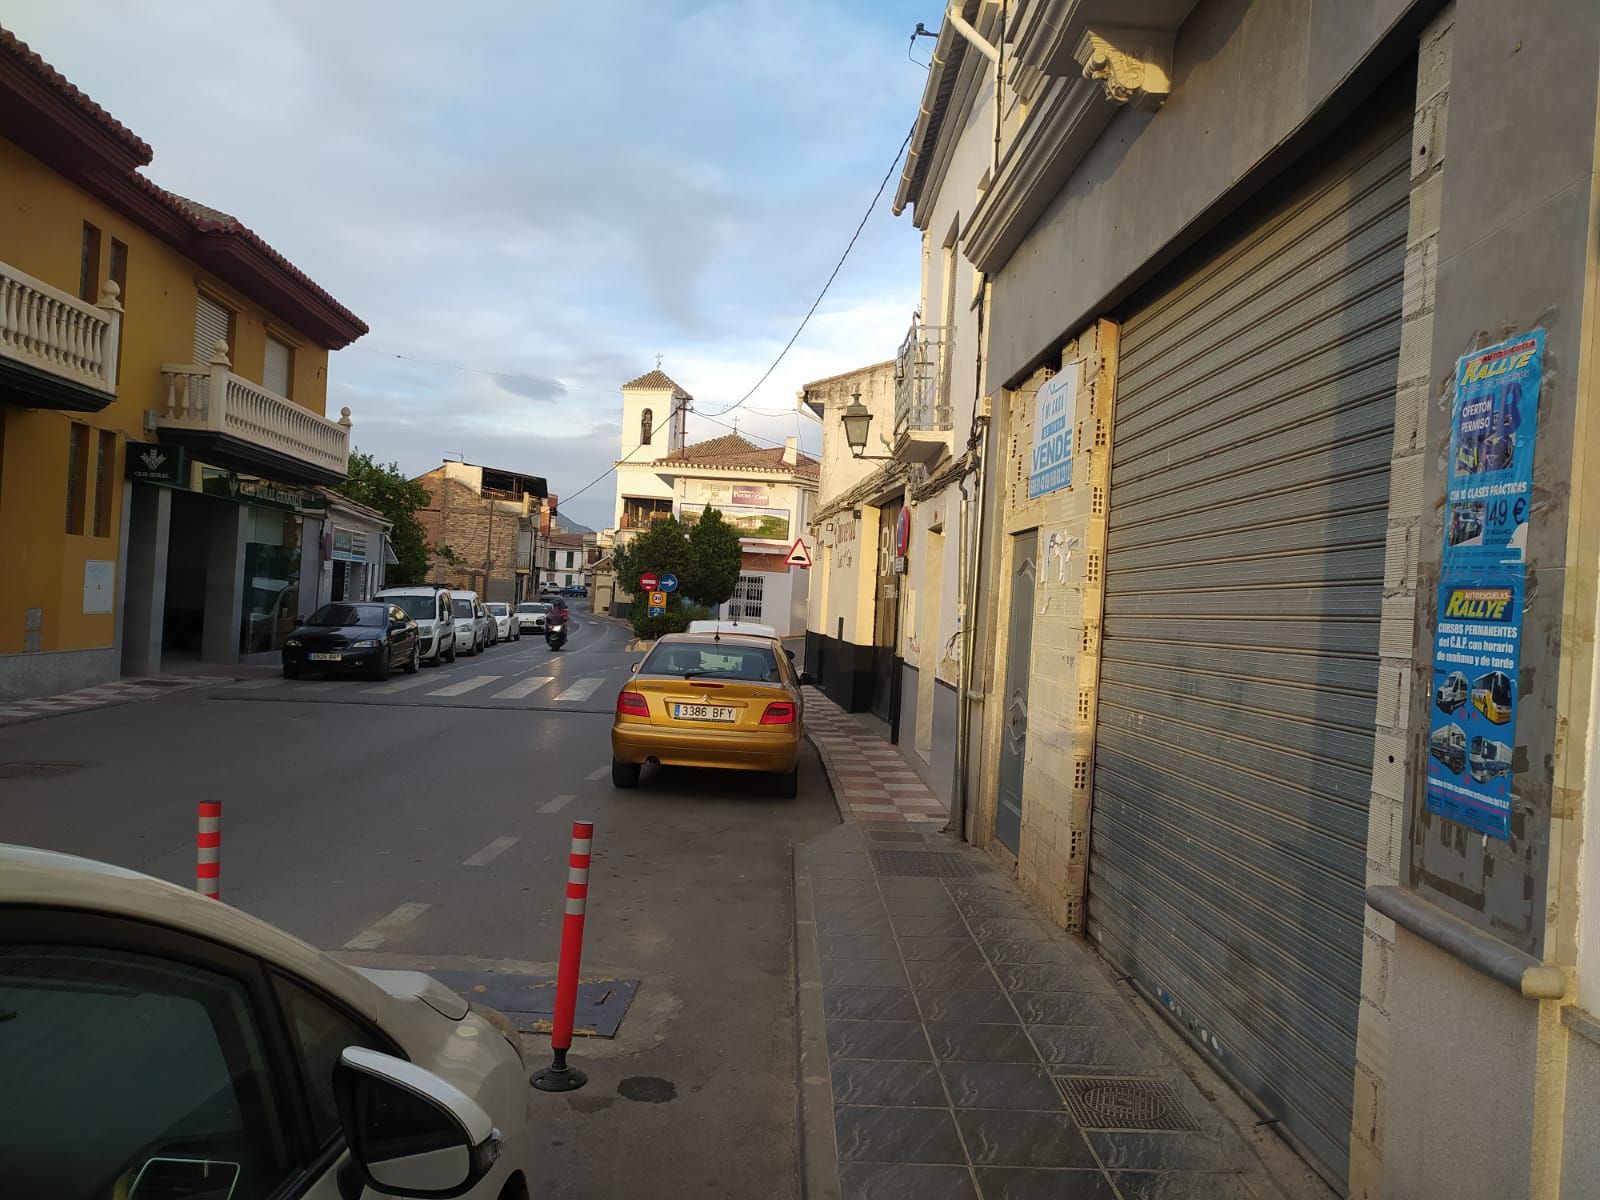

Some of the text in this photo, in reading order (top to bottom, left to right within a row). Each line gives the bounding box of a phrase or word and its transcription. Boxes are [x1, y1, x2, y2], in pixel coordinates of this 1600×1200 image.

[1460, 349, 1536, 386] RALLYE
[1461, 417, 1491, 433] PERMISO
[1033, 428, 1072, 472] VENDE
[1467, 486, 1489, 498] CLASES
[1513, 497, 1526, 525] €
[881, 523, 898, 576] BA
[1464, 591, 1509, 600] AUTOESCUELAS
[1445, 591, 1508, 619] RALLYE
[1438, 623, 1517, 638] CURSOS PERMANENTES
[1438, 637, 1449, 647] del
[1468, 641, 1482, 650] con
[1483, 640, 1514, 653] horario
[1436, 650, 1514, 669] de mañana y de tarde
[681, 704, 733, 719] 3386 BFY
